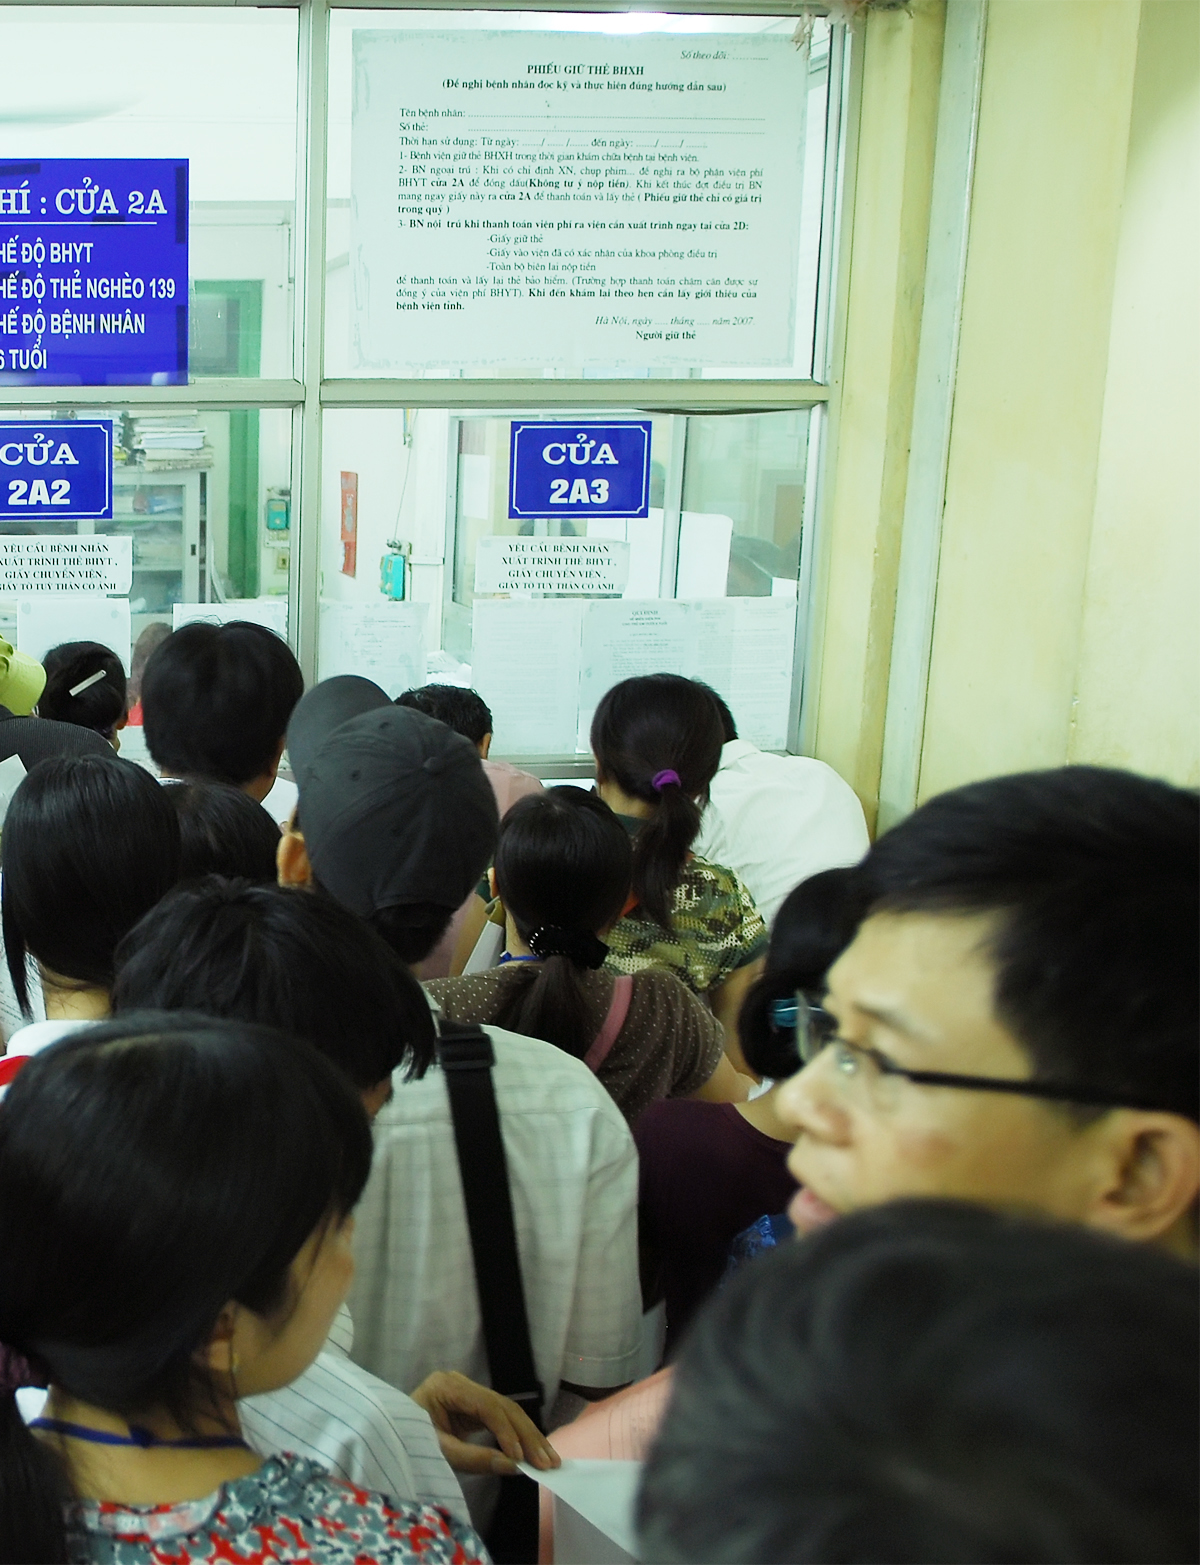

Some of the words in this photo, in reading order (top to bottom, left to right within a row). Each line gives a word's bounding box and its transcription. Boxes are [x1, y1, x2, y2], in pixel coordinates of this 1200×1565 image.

[527, 61, 561, 74] PHIẾU
[564, 64, 585, 74] GIỮ
[587, 63, 609, 75] THẺ
[613, 66, 644, 75] BHXH
[55, 176, 117, 215] CỬA
[127, 189, 167, 215] 2A
[21, 238, 46, 268] ĐỘ
[50, 242, 93, 263] BHYT
[21, 273, 46, 304] ĐỘ
[50, 269, 82, 298] THẺ
[86, 273, 145, 299] NGHÈO
[149, 278, 176, 299] 139
[21, 309, 46, 339] ĐỘ
[50, 309, 95, 339] BỆNH
[99, 309, 145, 334] NHÂN
[9, 338, 47, 369] TUỔI
[542, 433, 618, 466] CỬA
[7, 479, 71, 505] 2A2
[549, 479, 609, 504] 2A3
[3, 543, 24, 552] YÊU
[26, 542, 48, 552] CẦU
[50, 544, 77, 554] BỆNH
[80, 544, 109, 552] NHÂN
[508, 543, 529, 552] YÊU
[530, 541, 550, 552] CẦU
[553, 544, 579, 553] BỆNH
[582, 543, 609, 552] NHÂN
[28, 557, 59, 566] TRÌNH
[62, 555, 83, 566] THẺ
[86, 558, 113, 566] BHYT
[502, 555, 528, 565] XUẤT
[531, 556, 561, 565] TRÌNH
[563, 555, 584, 565] THẺ
[5, 568, 30, 579] GIẤY
[33, 568, 75, 579] CHUYỂN
[78, 570, 102, 580] VIỆN
[508, 568, 532, 578] GIẤY
[535, 567, 575, 578] CHUYỂN
[578, 570, 601, 579] VIỆN
